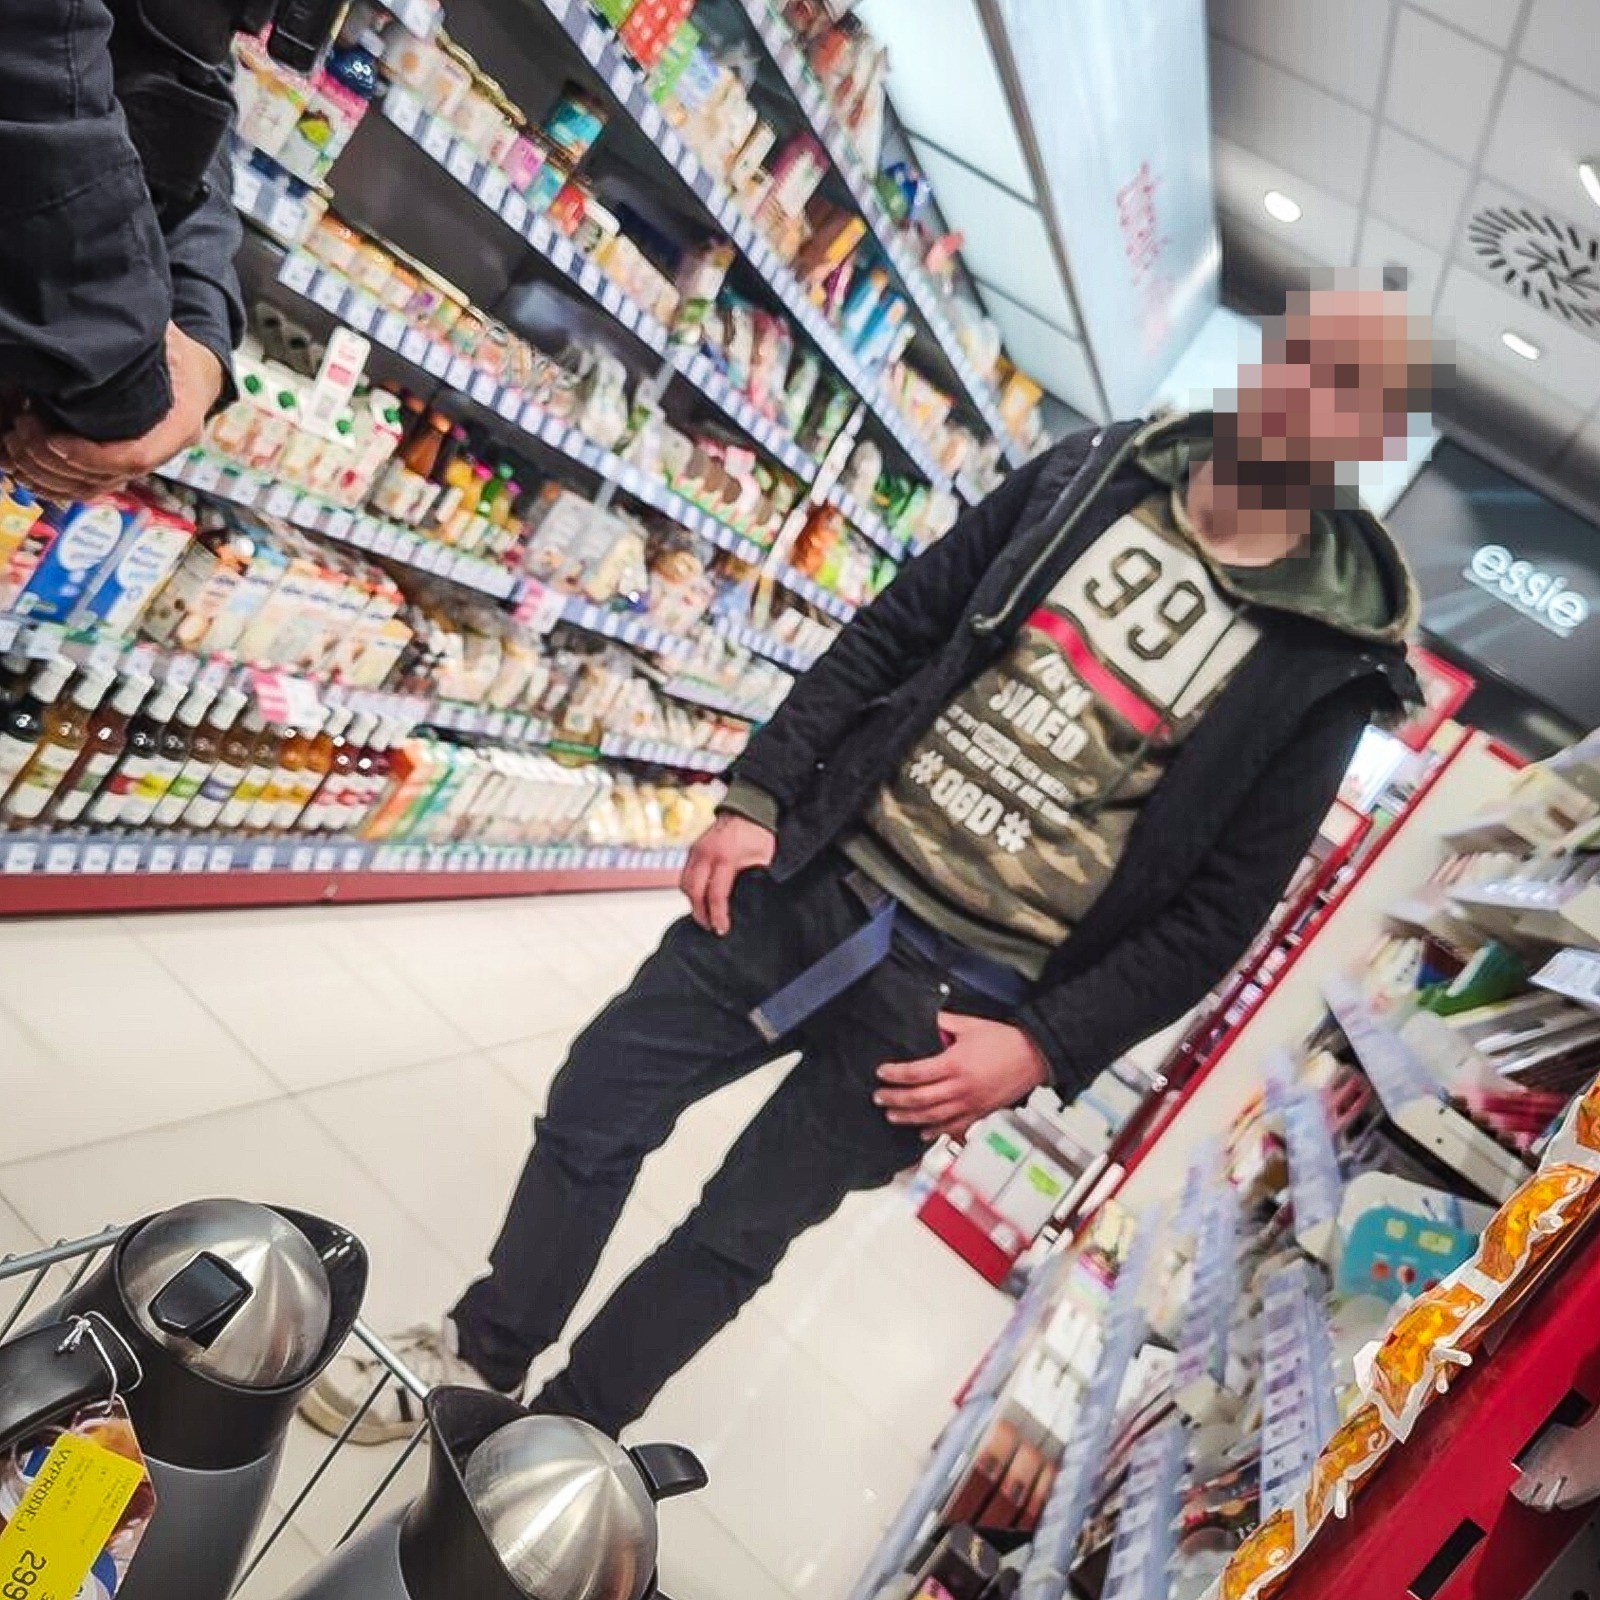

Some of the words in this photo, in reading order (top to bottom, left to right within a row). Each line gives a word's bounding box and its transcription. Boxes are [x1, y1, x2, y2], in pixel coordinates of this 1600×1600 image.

[1085, 547, 1206, 661] 99
[1472, 544, 1588, 628] essie
[2, 1550, 47, 1600] 299
